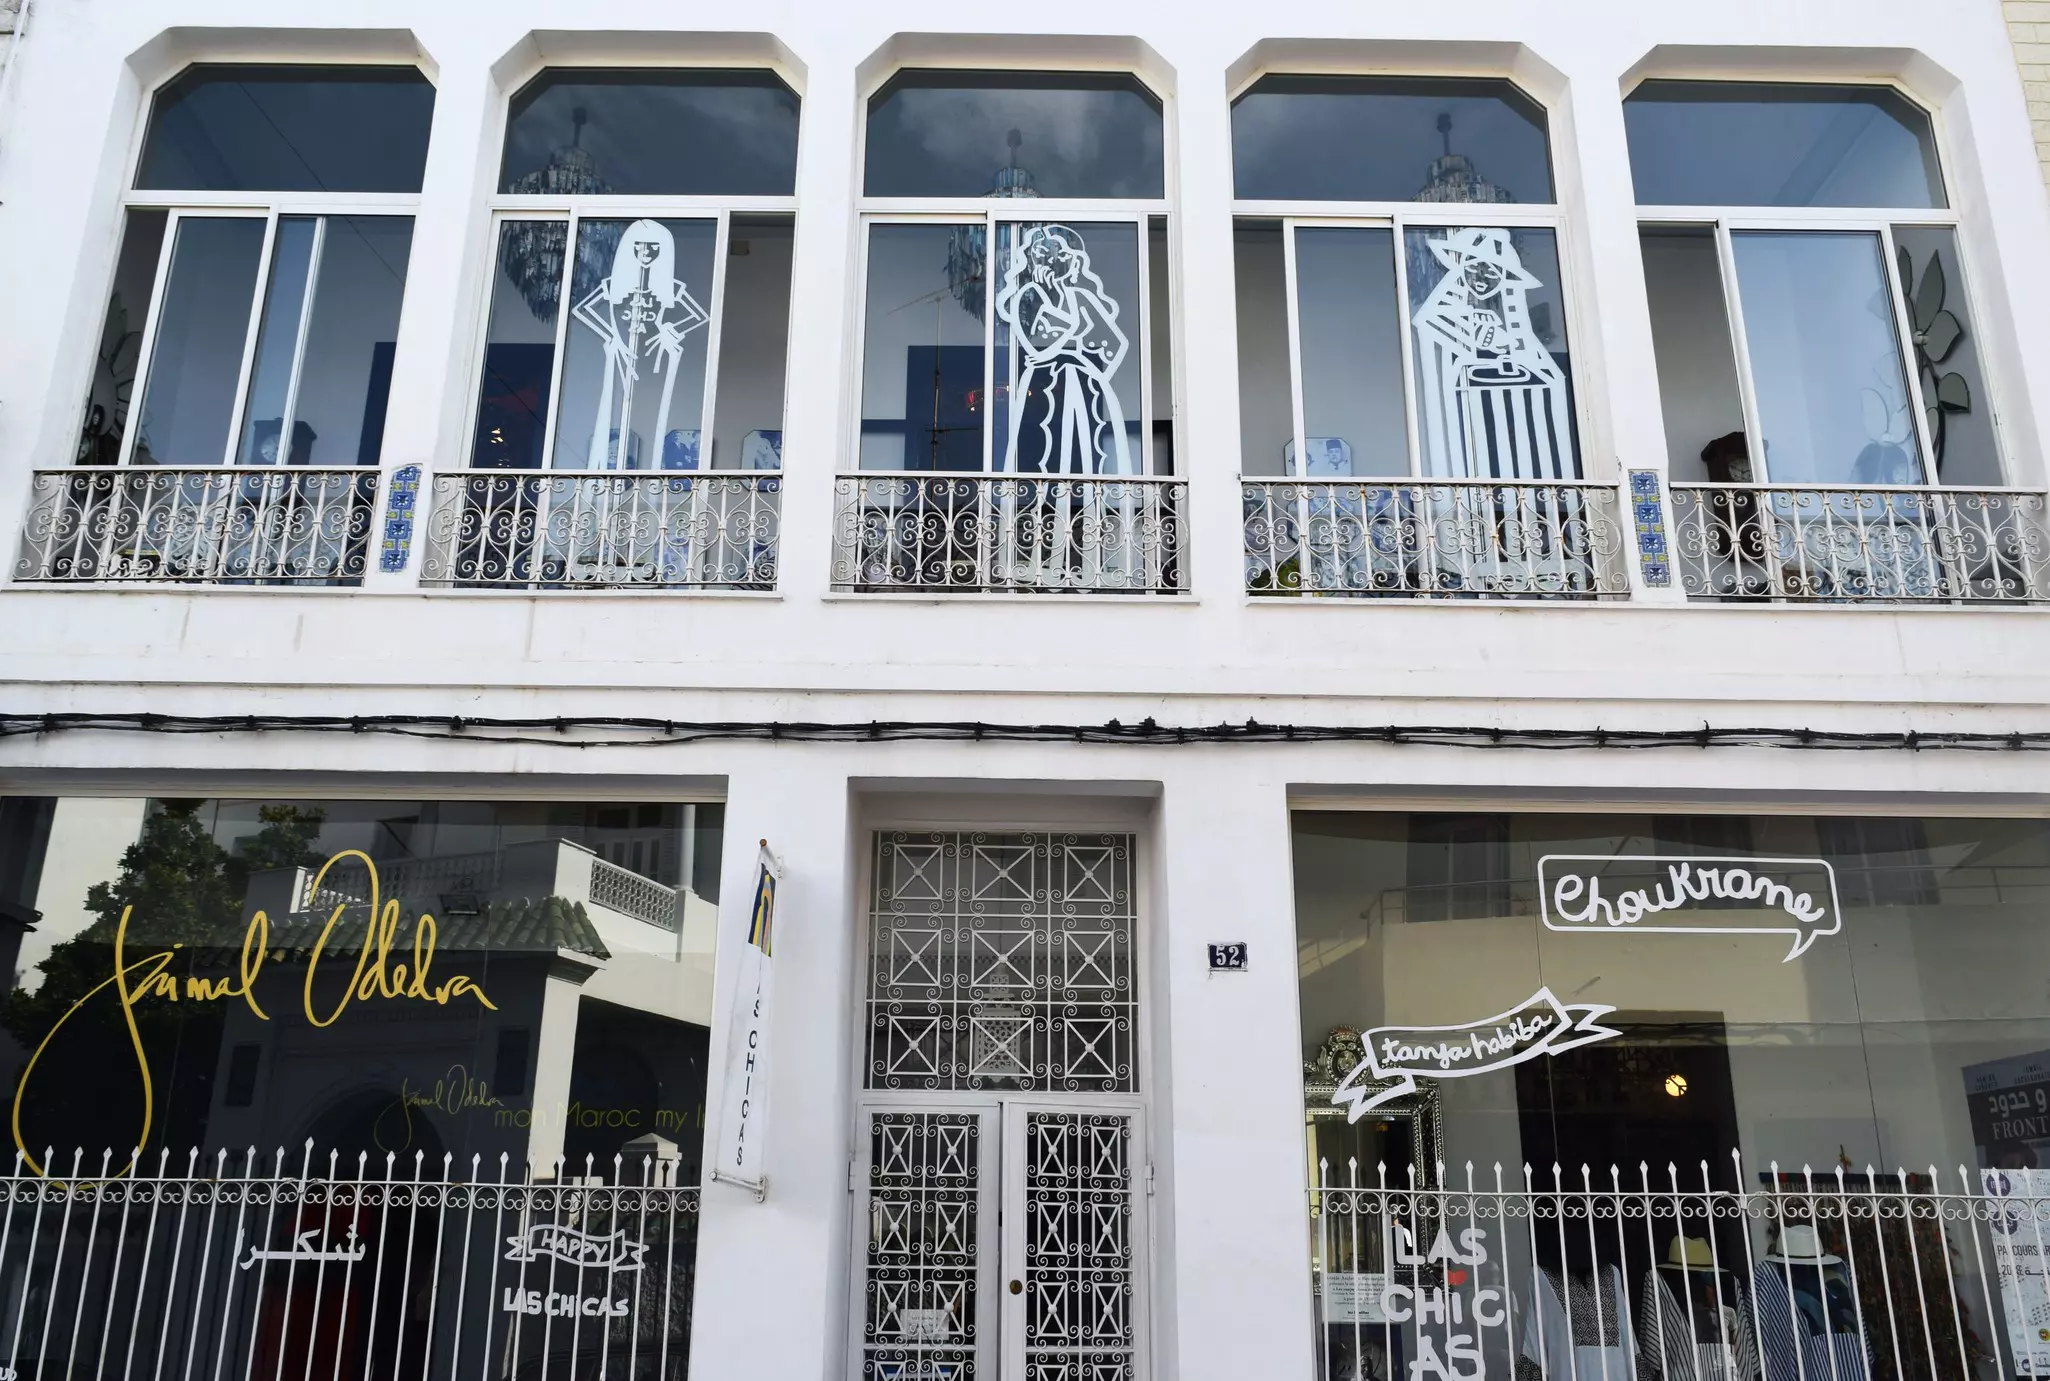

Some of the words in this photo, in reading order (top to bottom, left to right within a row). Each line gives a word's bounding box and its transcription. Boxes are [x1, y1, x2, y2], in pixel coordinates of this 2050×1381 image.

[1215, 945, 1240, 966] 52
[1469, 1014, 1553, 1060] habiba
[736, 1029, 758, 1167] CHICAS
[494, 1109, 546, 1128] mon
[556, 1101, 641, 1128] Maroc
[655, 1108, 688, 1133] my
[541, 1229, 608, 1263] HAPPY
[1394, 1223, 1488, 1266] LAS
[1996, 1244, 2040, 1257] PACOURS
[2001, 1264, 2023, 1276] 208
[503, 1287, 543, 1315] LAS
[544, 1291, 629, 1318] CHICAS
[1380, 1284, 1506, 1327] CHIC
[1409, 1334, 1487, 1381] AS
